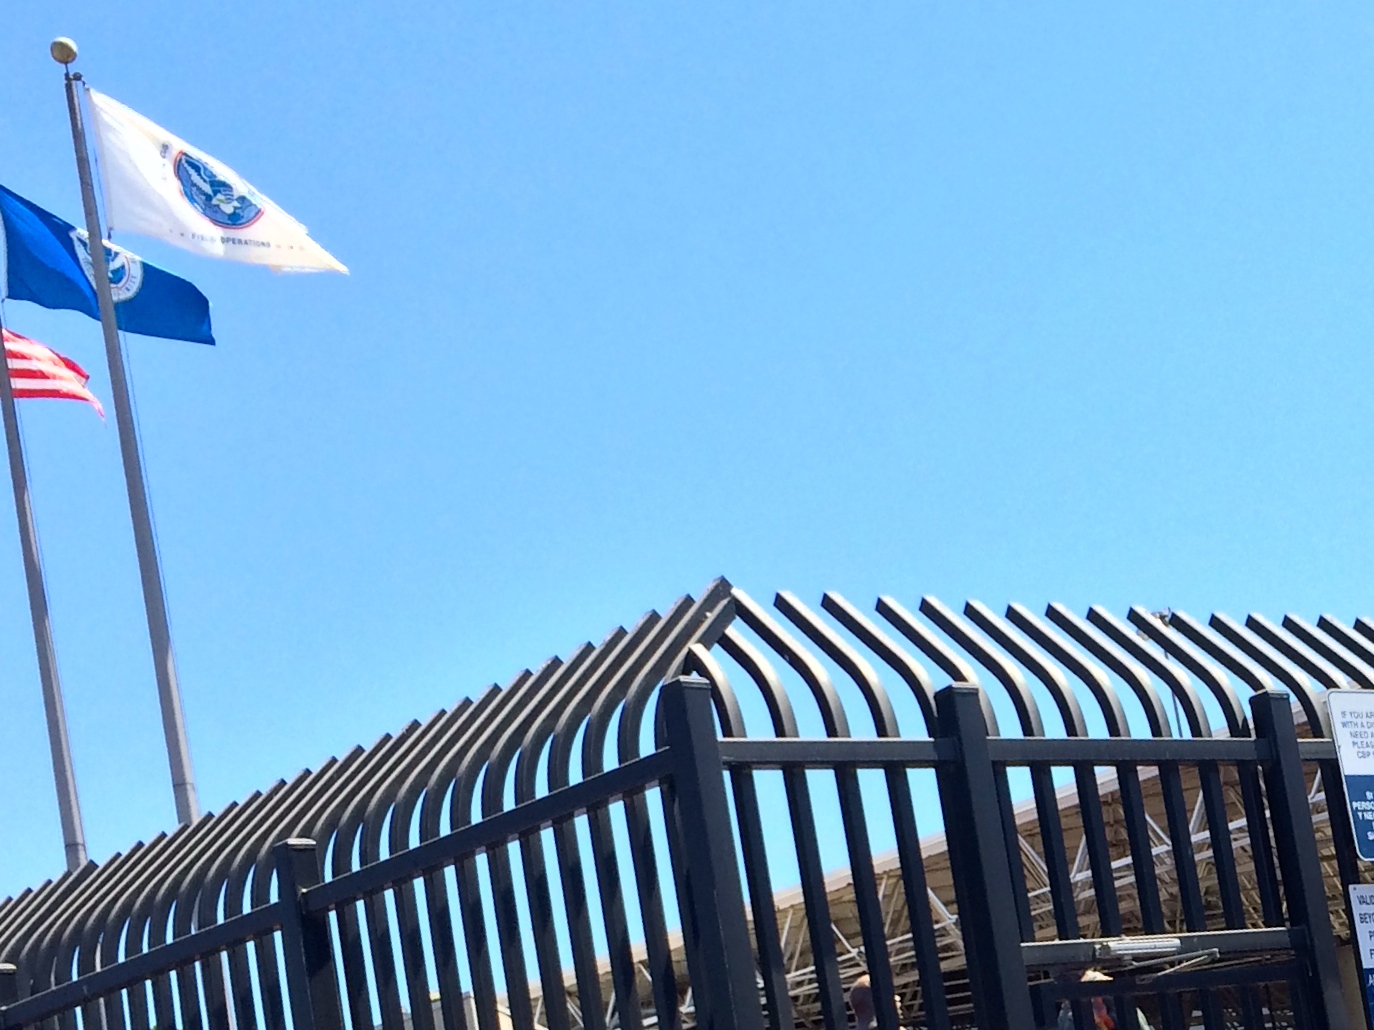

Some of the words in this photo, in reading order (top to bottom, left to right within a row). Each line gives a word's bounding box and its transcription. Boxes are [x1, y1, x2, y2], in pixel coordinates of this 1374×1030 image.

[1349, 711, 1363, 719] YOU
[1341, 721, 1359, 729] WITH
[1350, 731, 1369, 739] NEED
[1357, 751, 1371, 759] CBP
